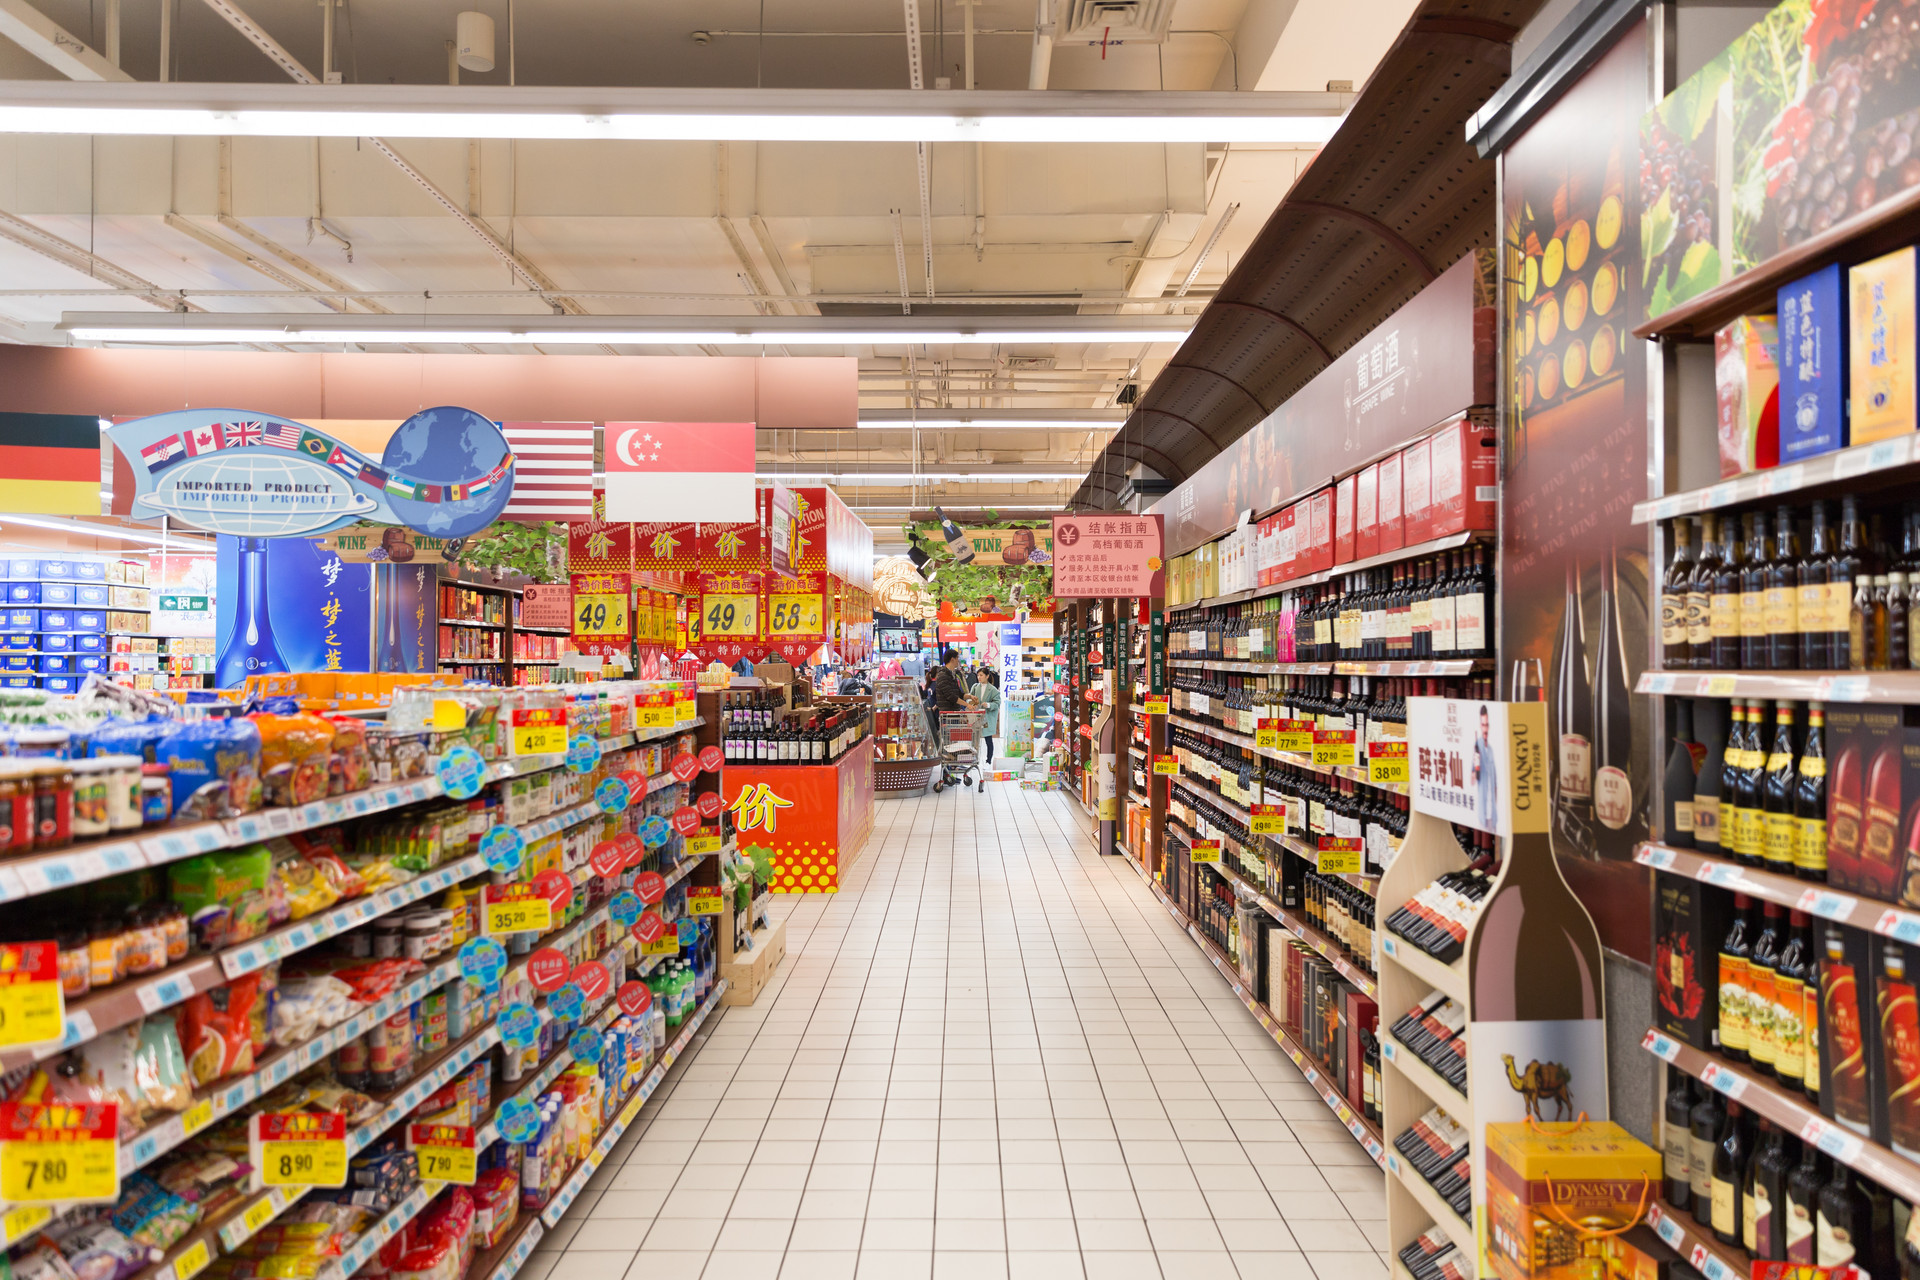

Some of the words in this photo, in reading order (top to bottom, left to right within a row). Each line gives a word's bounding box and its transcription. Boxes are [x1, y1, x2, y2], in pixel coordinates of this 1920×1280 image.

[1357, 329, 1399, 392] 葡萄酒
[176, 481, 252, 492] IMPORTED
[264, 482, 332, 494] PRODUCT
[183, 492, 259, 503] IMPORTED
[271, 494, 338, 505] PRODUCT
[1089, 521, 1148, 534] 结帐指南
[338, 535, 366, 550] WINE
[414, 535, 443, 550] WINE
[973, 538, 1002, 552] WINE
[1092, 540, 1144, 549] 高档葡萄酒
[1068, 554, 1107, 562] 选定商品后
[1068, 564, 1139, 572] 服务人员处开具小票
[578, 578, 625, 592] 特价商品
[708, 579, 753, 591] 特价商品
[773, 578, 819, 591] 特价商品
[579, 603, 607, 631] 49
[615, 613, 623, 626] 8
[708, 603, 735, 631] 49
[773, 603, 801, 631] 58
[589, 644, 613, 656] 特价
[718, 645, 741, 656] 特价
[783, 645, 808, 656] 特价
[1418, 747, 1464, 790] 醉诗仙
[1512, 723, 1533, 811] CHANGYU
[730, 783, 794, 833] 价
[1557, 1183, 1632, 1201] DYNASTY
